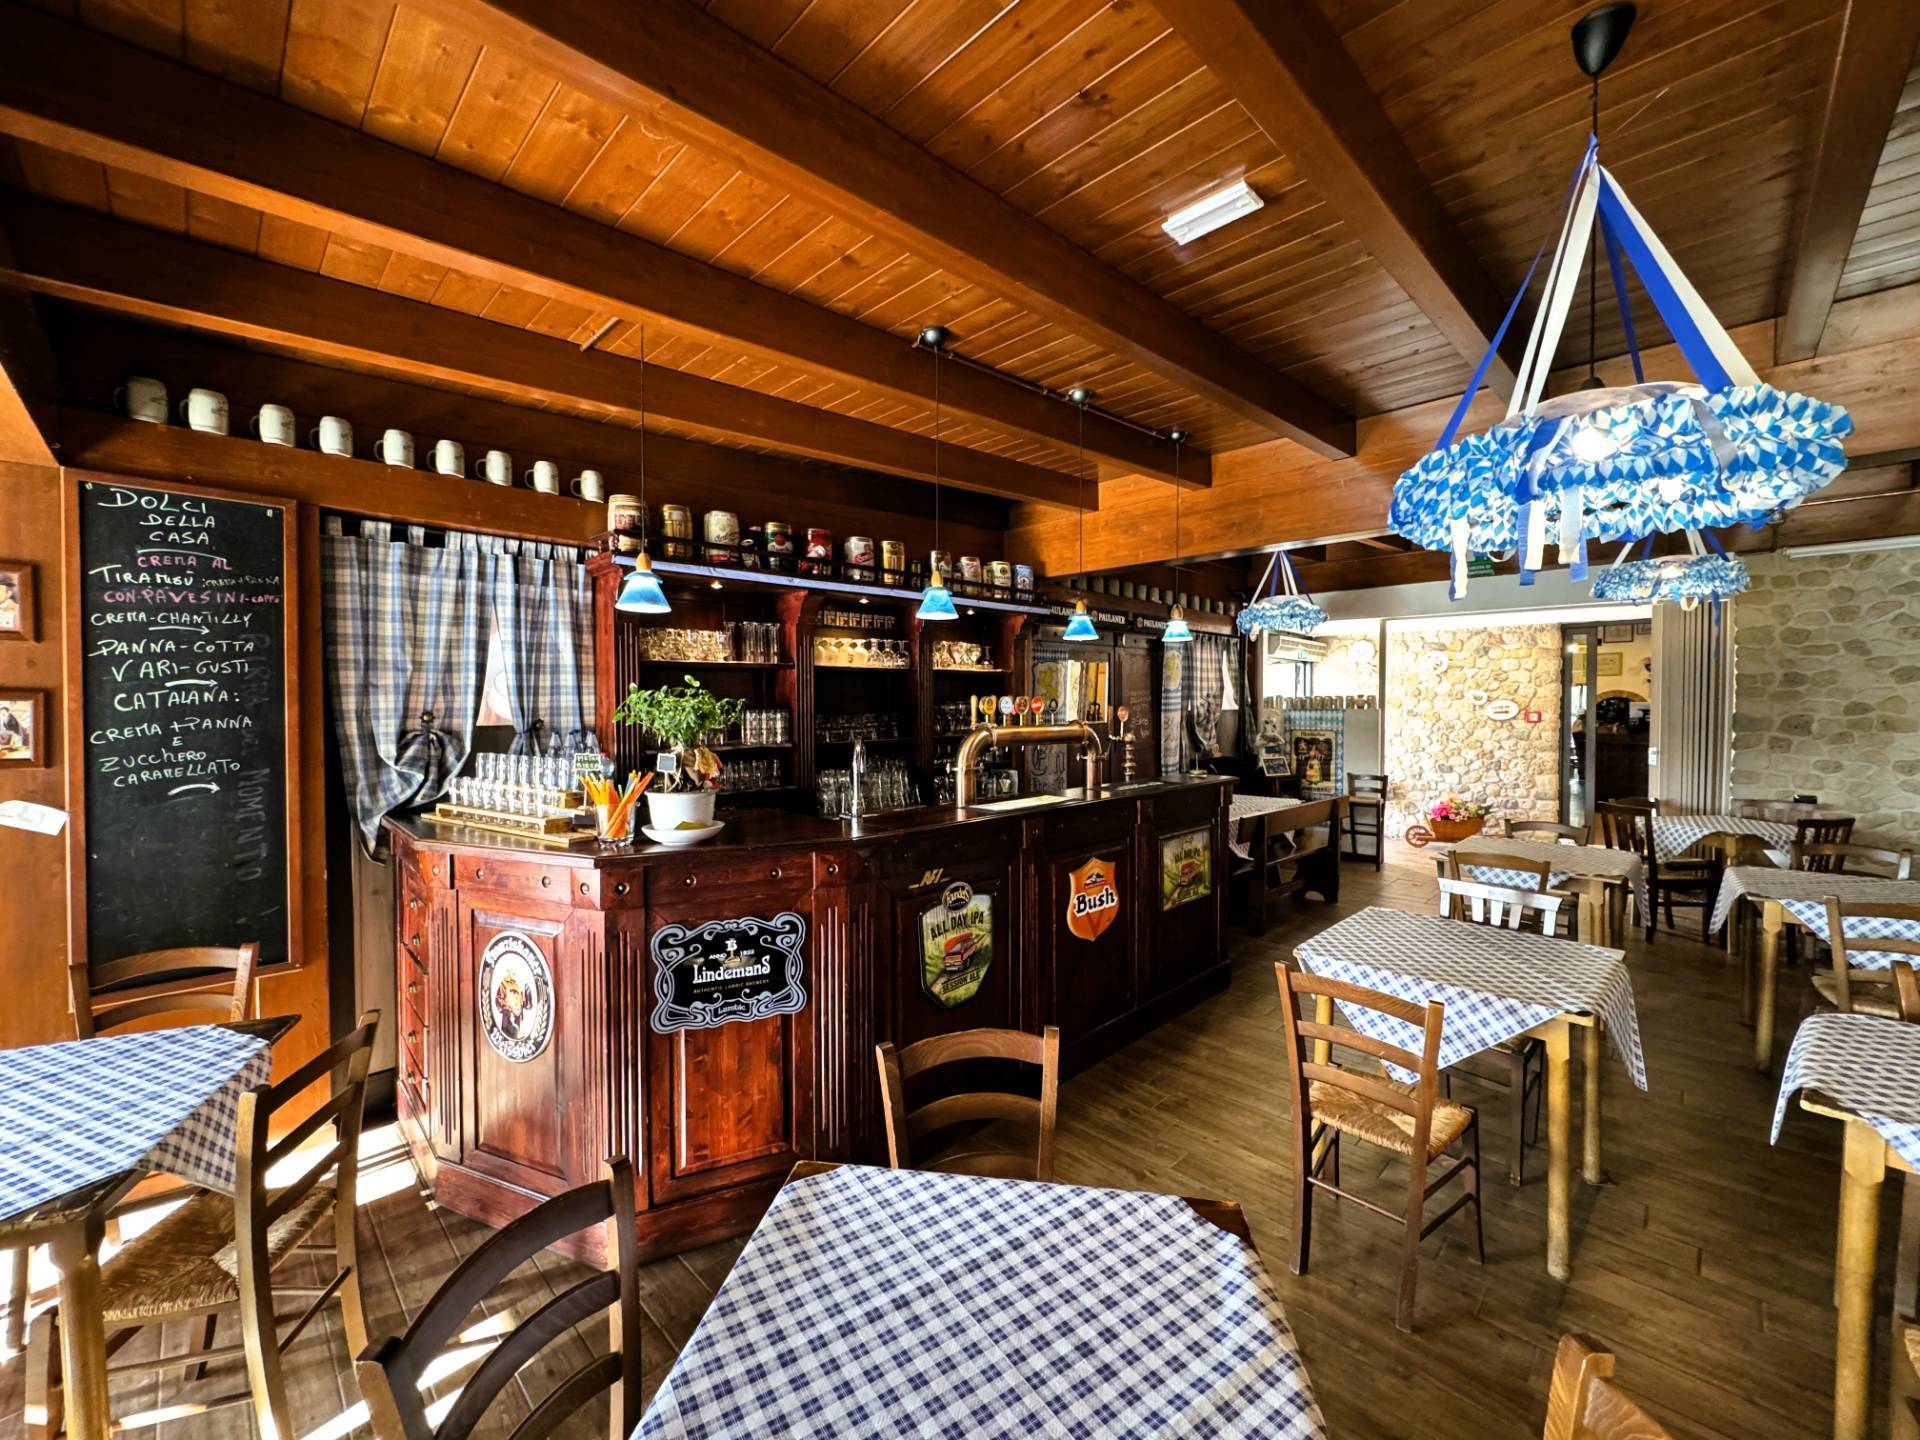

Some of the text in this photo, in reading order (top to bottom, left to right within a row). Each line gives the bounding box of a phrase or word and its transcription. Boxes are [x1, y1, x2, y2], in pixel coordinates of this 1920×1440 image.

[97, 488, 206, 514] DOLCI
[139, 514, 215, 528] DELLA
[150, 531, 209, 544] CASA
[137, 556, 232, 570] CREMA AL
[1099, 612, 1125, 624] PAULANER
[90, 723, 162, 745] CREMA
[172, 736, 183, 746] E
[114, 759, 240, 787] CARAMELLATO
[1076, 887, 1116, 914] Bush
[930, 911, 984, 941] ALL DAY IPA
[942, 976, 969, 992] SESSION
